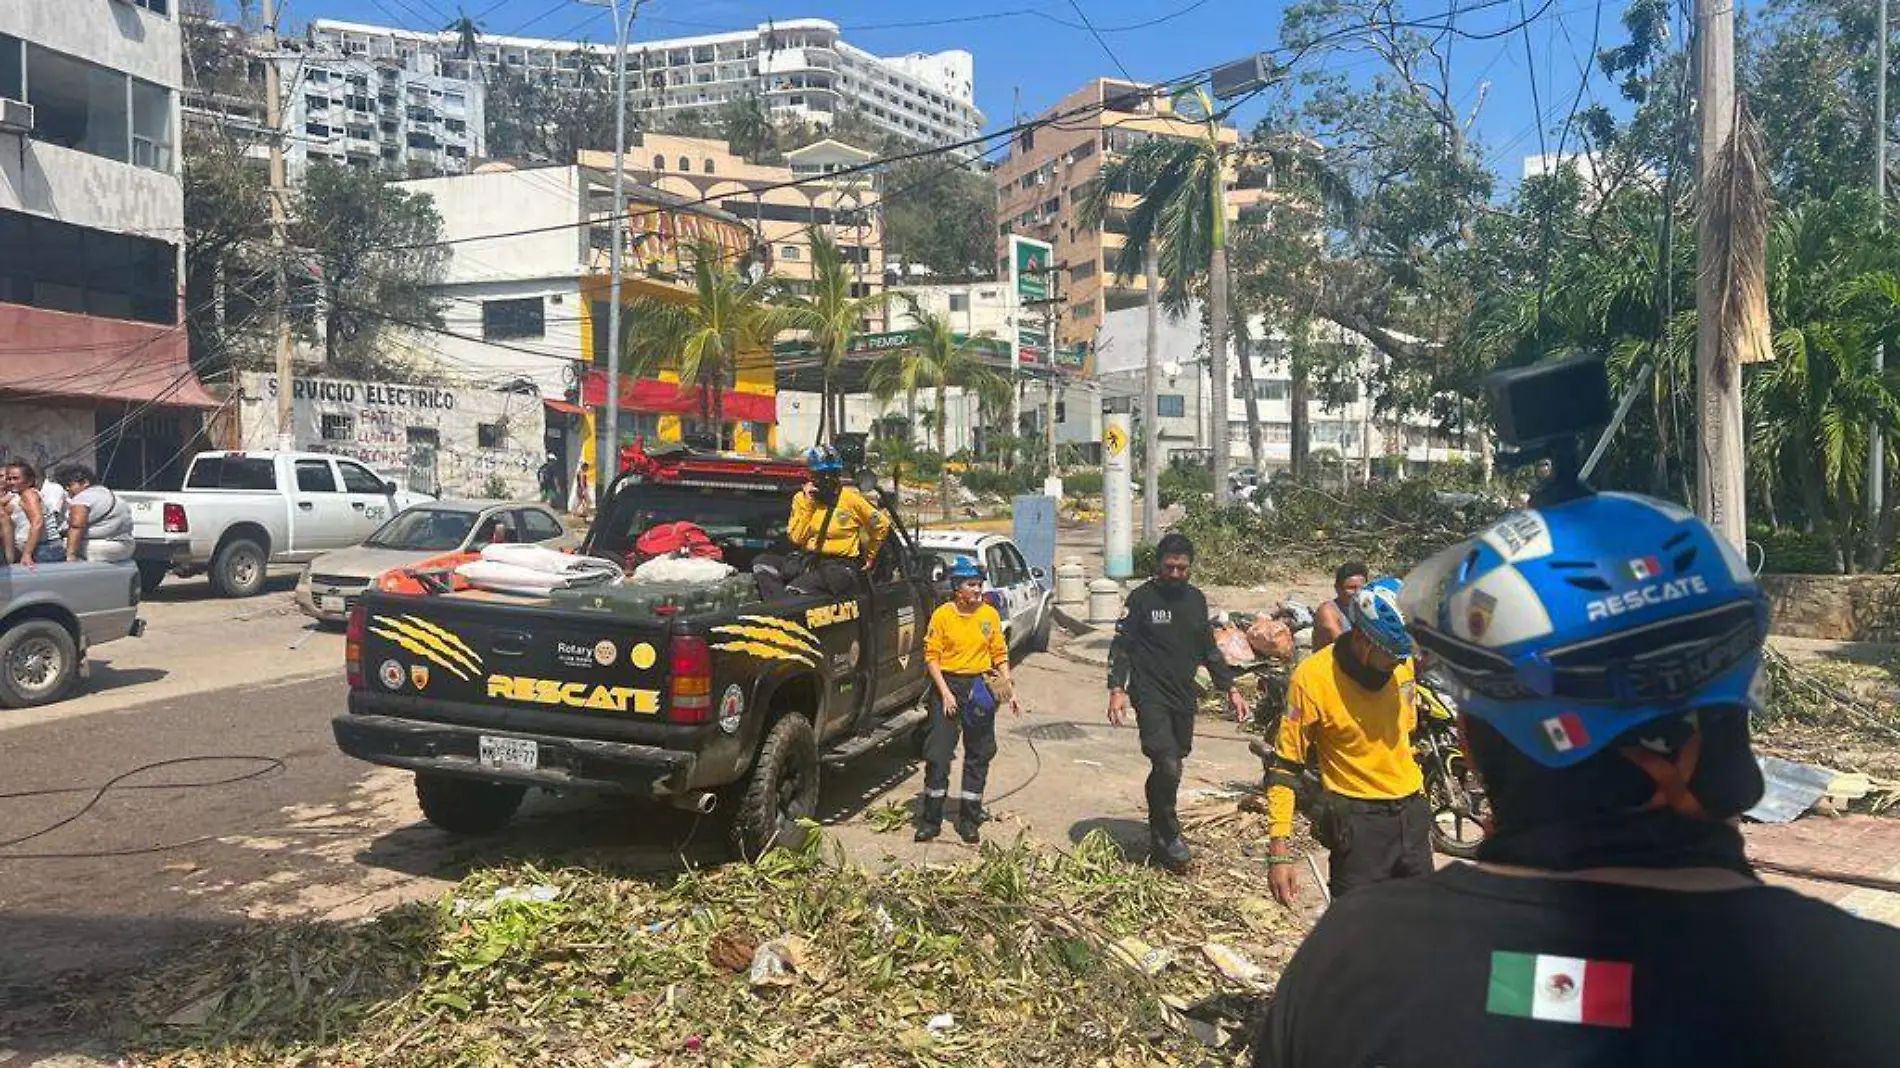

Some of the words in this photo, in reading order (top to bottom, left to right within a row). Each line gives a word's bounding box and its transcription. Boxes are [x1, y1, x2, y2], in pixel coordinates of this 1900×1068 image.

[869, 335, 909, 349] PEMEX
[268, 378, 355, 402] SRVICIO
[365, 506, 385, 520] CFE
[1586, 575, 1708, 622] RESCATE
[558, 642, 593, 658] Rotary
[487, 674, 661, 714] RESCATE
